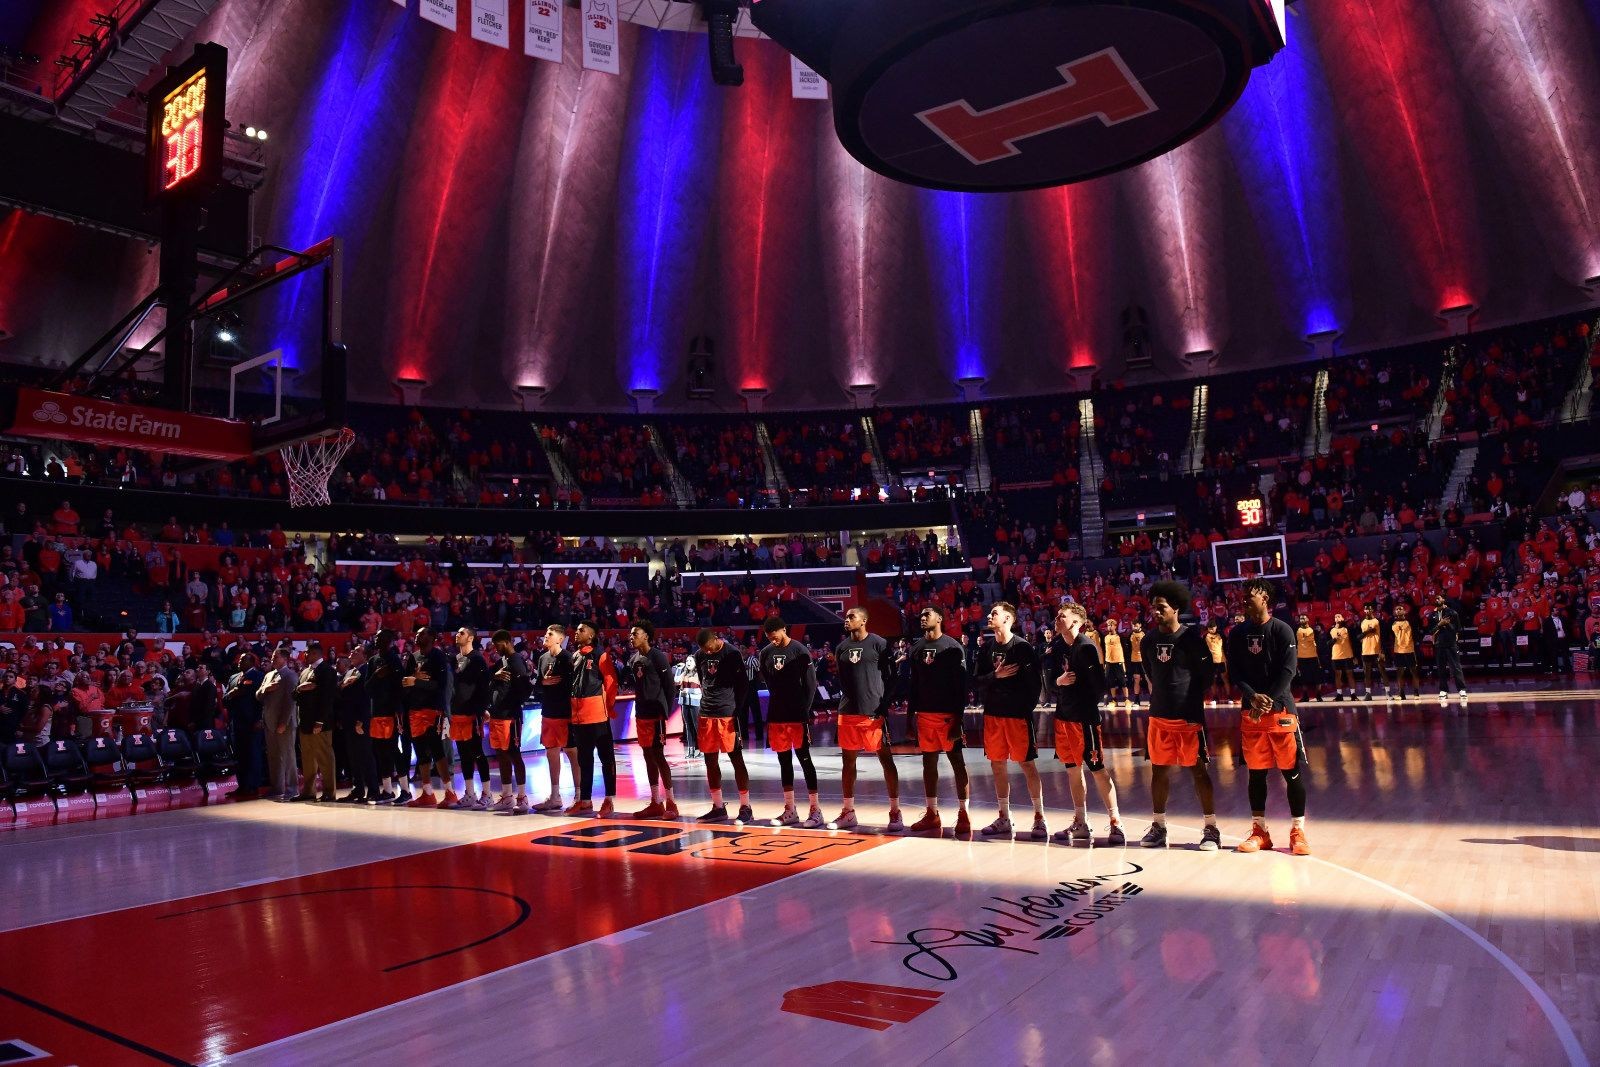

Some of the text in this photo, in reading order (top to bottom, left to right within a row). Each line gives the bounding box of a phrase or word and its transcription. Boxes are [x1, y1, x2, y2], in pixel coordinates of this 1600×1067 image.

[532, 0, 557, 13] ILLINOIS
[538, 7, 550, 16] 22
[484, 12, 496, 22] ROD
[588, 14, 612, 25] ILLINOIS
[478, 16, 503, 30] FLETCHER
[594, 20, 606, 30] 35
[529, 27, 542, 36] JOHN
[537, 35, 550, 44] KERR
[591, 48, 610, 57] VAUGHN
[1236, 498, 1261, 510] 20:00
[1241, 509, 1260, 525] 30
[100, 719, 110, 728] G
[140, 717, 149, 725] G
[1064, 893, 1133, 927] COURT
